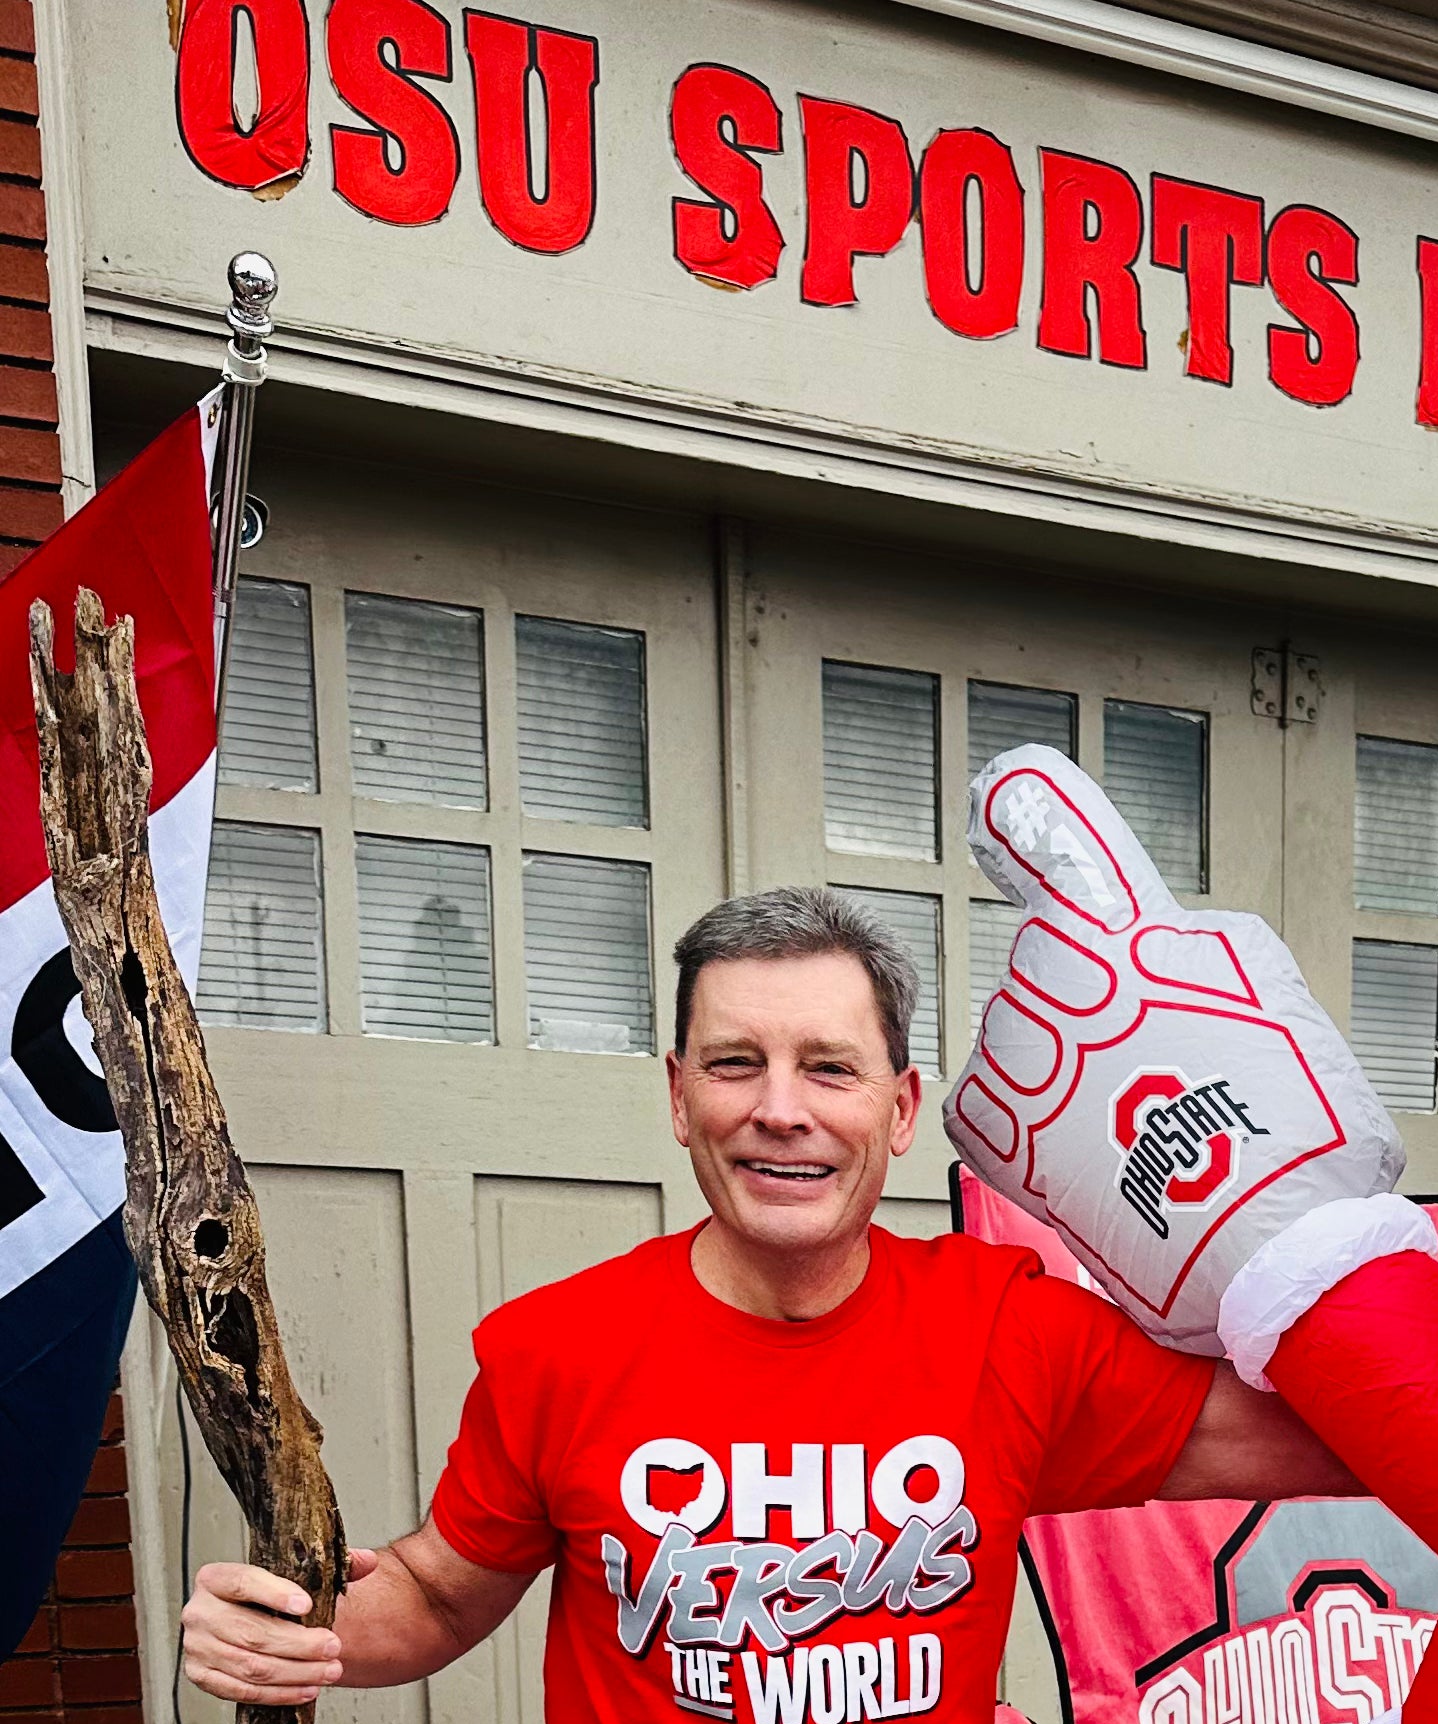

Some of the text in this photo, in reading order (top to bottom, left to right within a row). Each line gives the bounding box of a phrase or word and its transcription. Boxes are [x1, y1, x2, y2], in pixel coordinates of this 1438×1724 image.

[176, 0, 599, 254] OSU
[671, 62, 1360, 408] SPORTS
[1120, 1080, 1272, 1240] OHIO STATE
[619, 1434, 966, 1540] OHIO
[600, 1504, 981, 1656] VERSUS
[663, 1641, 735, 1705] THE
